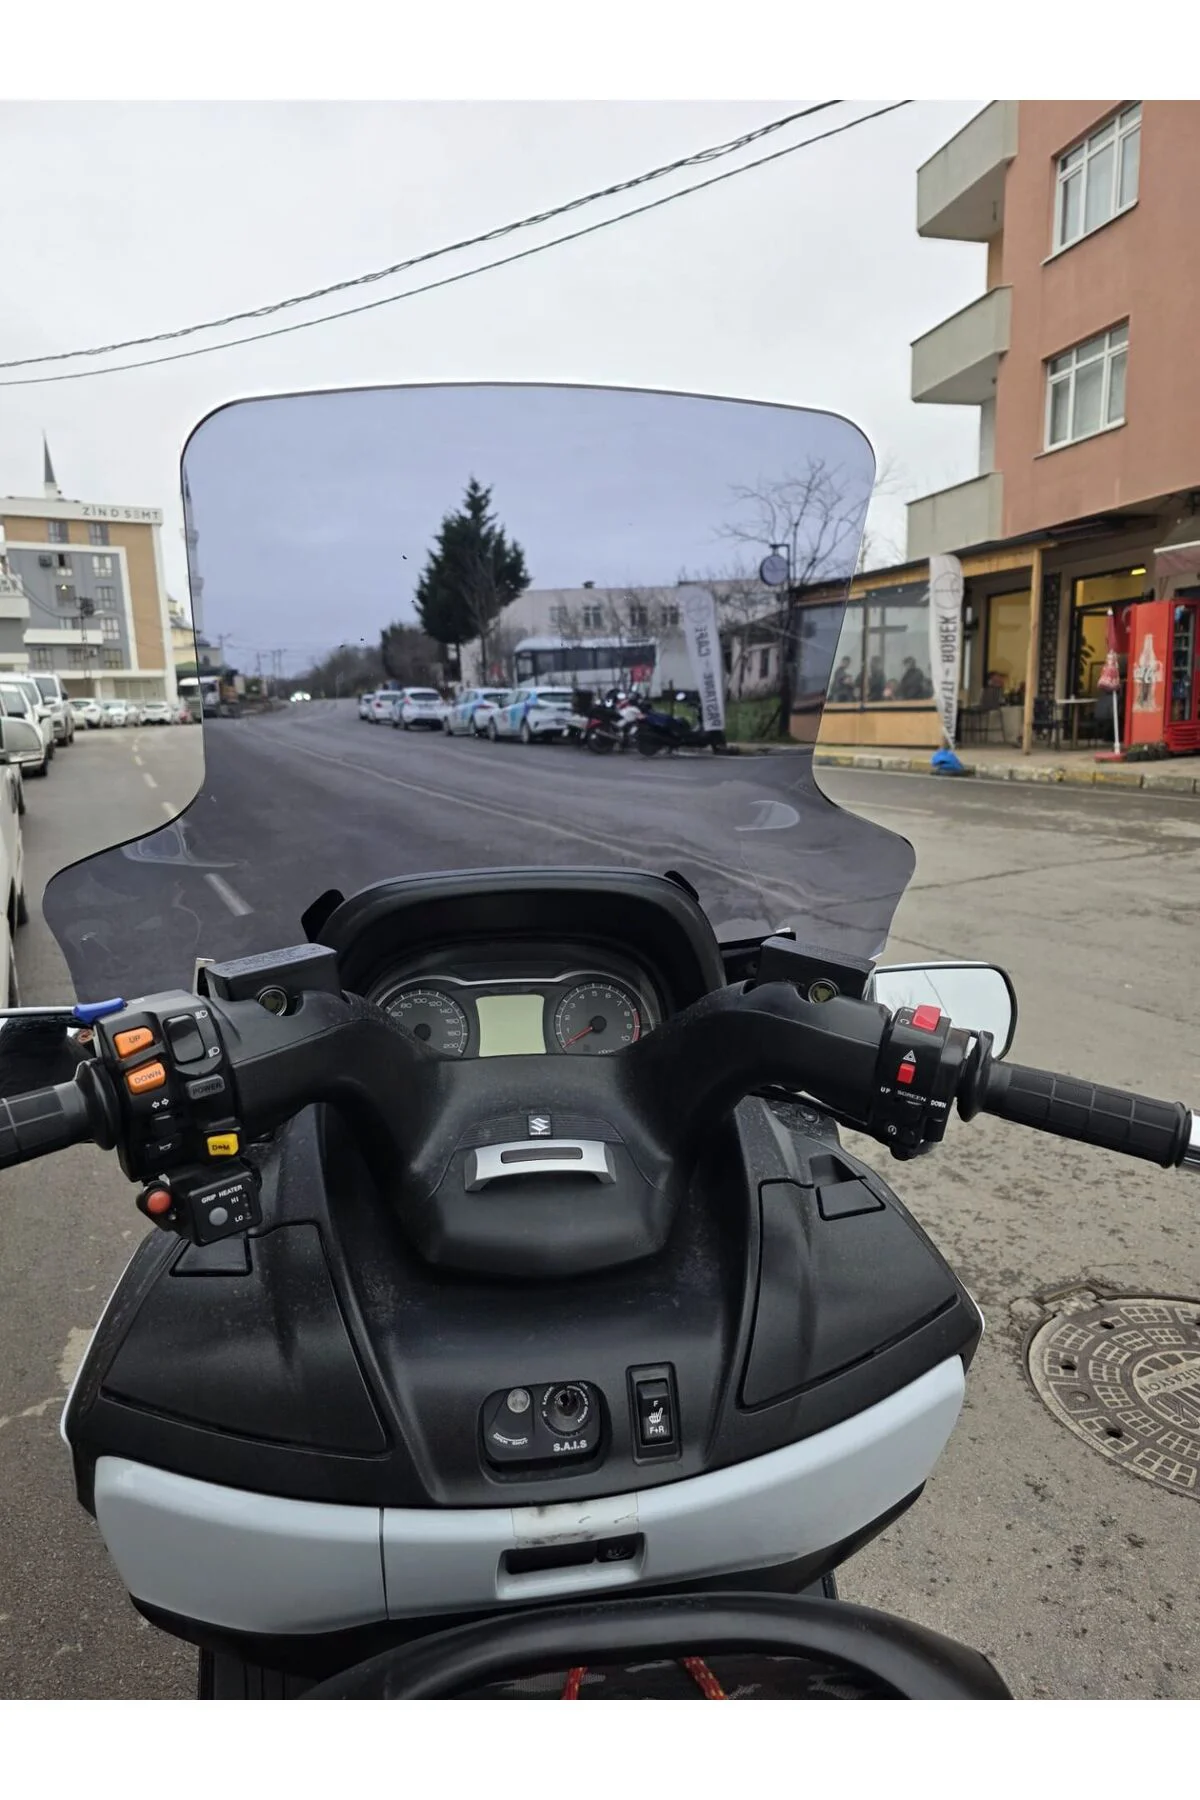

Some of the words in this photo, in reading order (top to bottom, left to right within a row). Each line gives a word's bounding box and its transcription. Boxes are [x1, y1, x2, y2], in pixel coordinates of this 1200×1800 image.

[128, 1034, 141, 1043] UP
[134, 1069, 162, 1084] DOWN
[192, 1081, 223, 1096] POWER
[880, 1086, 891, 1094] UP
[897, 1089, 927, 1102] SCREEN
[930, 1099, 947, 1109] DOWN
[201, 1193, 216, 1204] GRIP
[218, 1184, 243, 1198] HEATER
[230, 1196, 239, 1204] HI
[234, 1214, 244, 1222] LO
[649, 1425, 665, 1434] F+R
[553, 1439, 587, 1452] S.A.I.S
